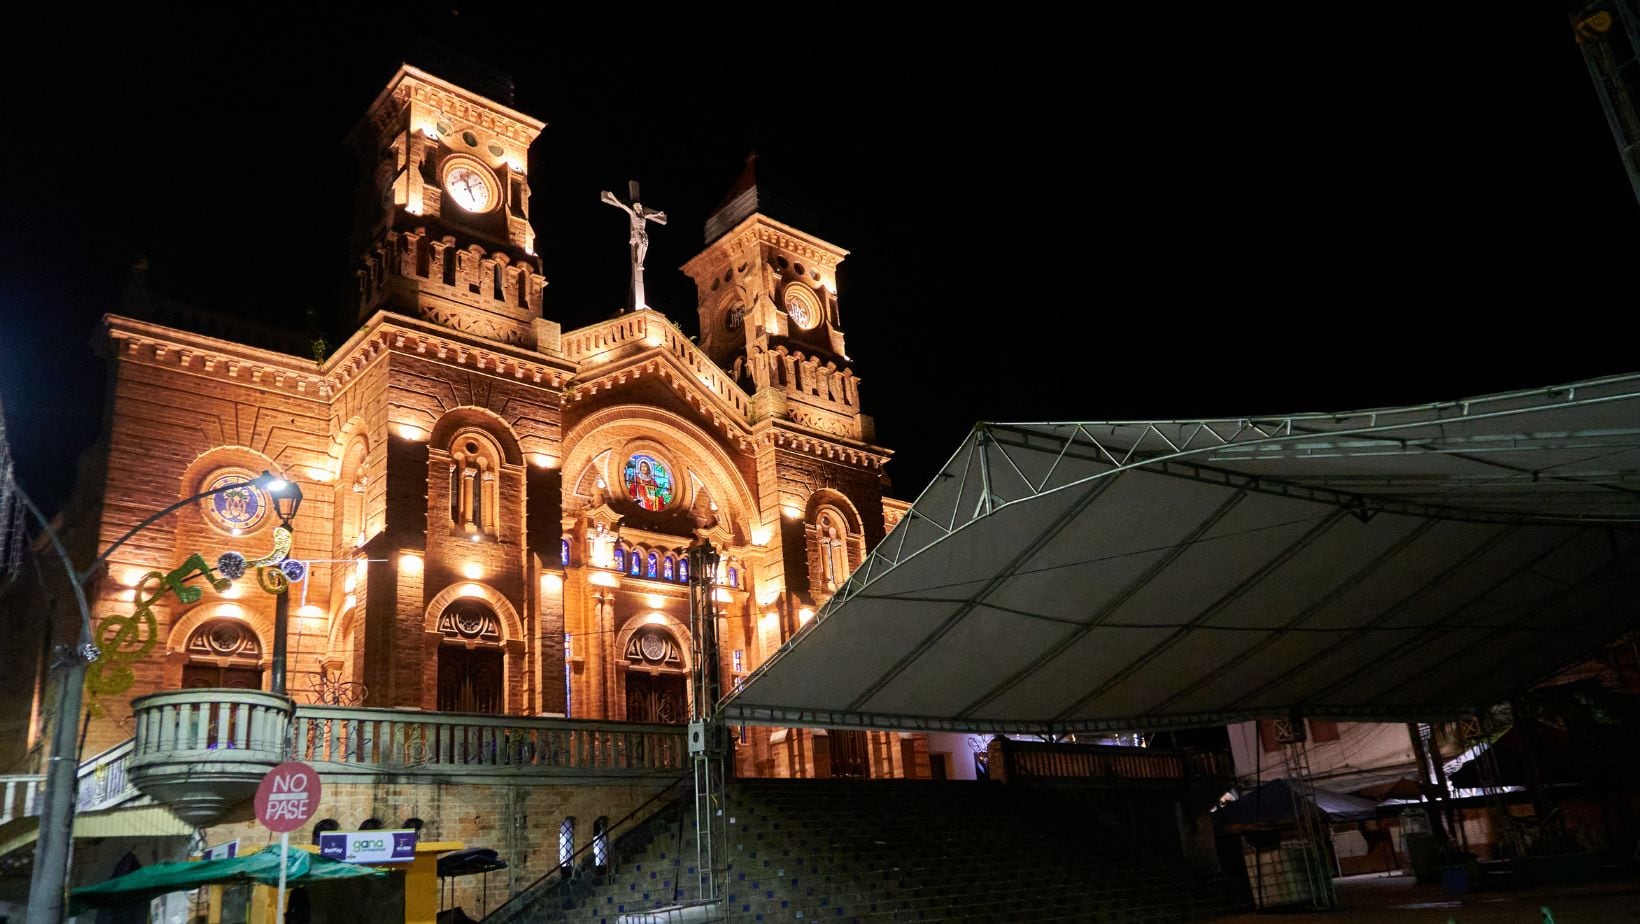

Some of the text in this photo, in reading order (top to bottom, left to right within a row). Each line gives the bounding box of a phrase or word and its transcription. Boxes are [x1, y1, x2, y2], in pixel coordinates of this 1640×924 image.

[272, 773, 308, 792] NO
[265, 800, 310, 820] PASE
[353, 839, 384, 852] gana
